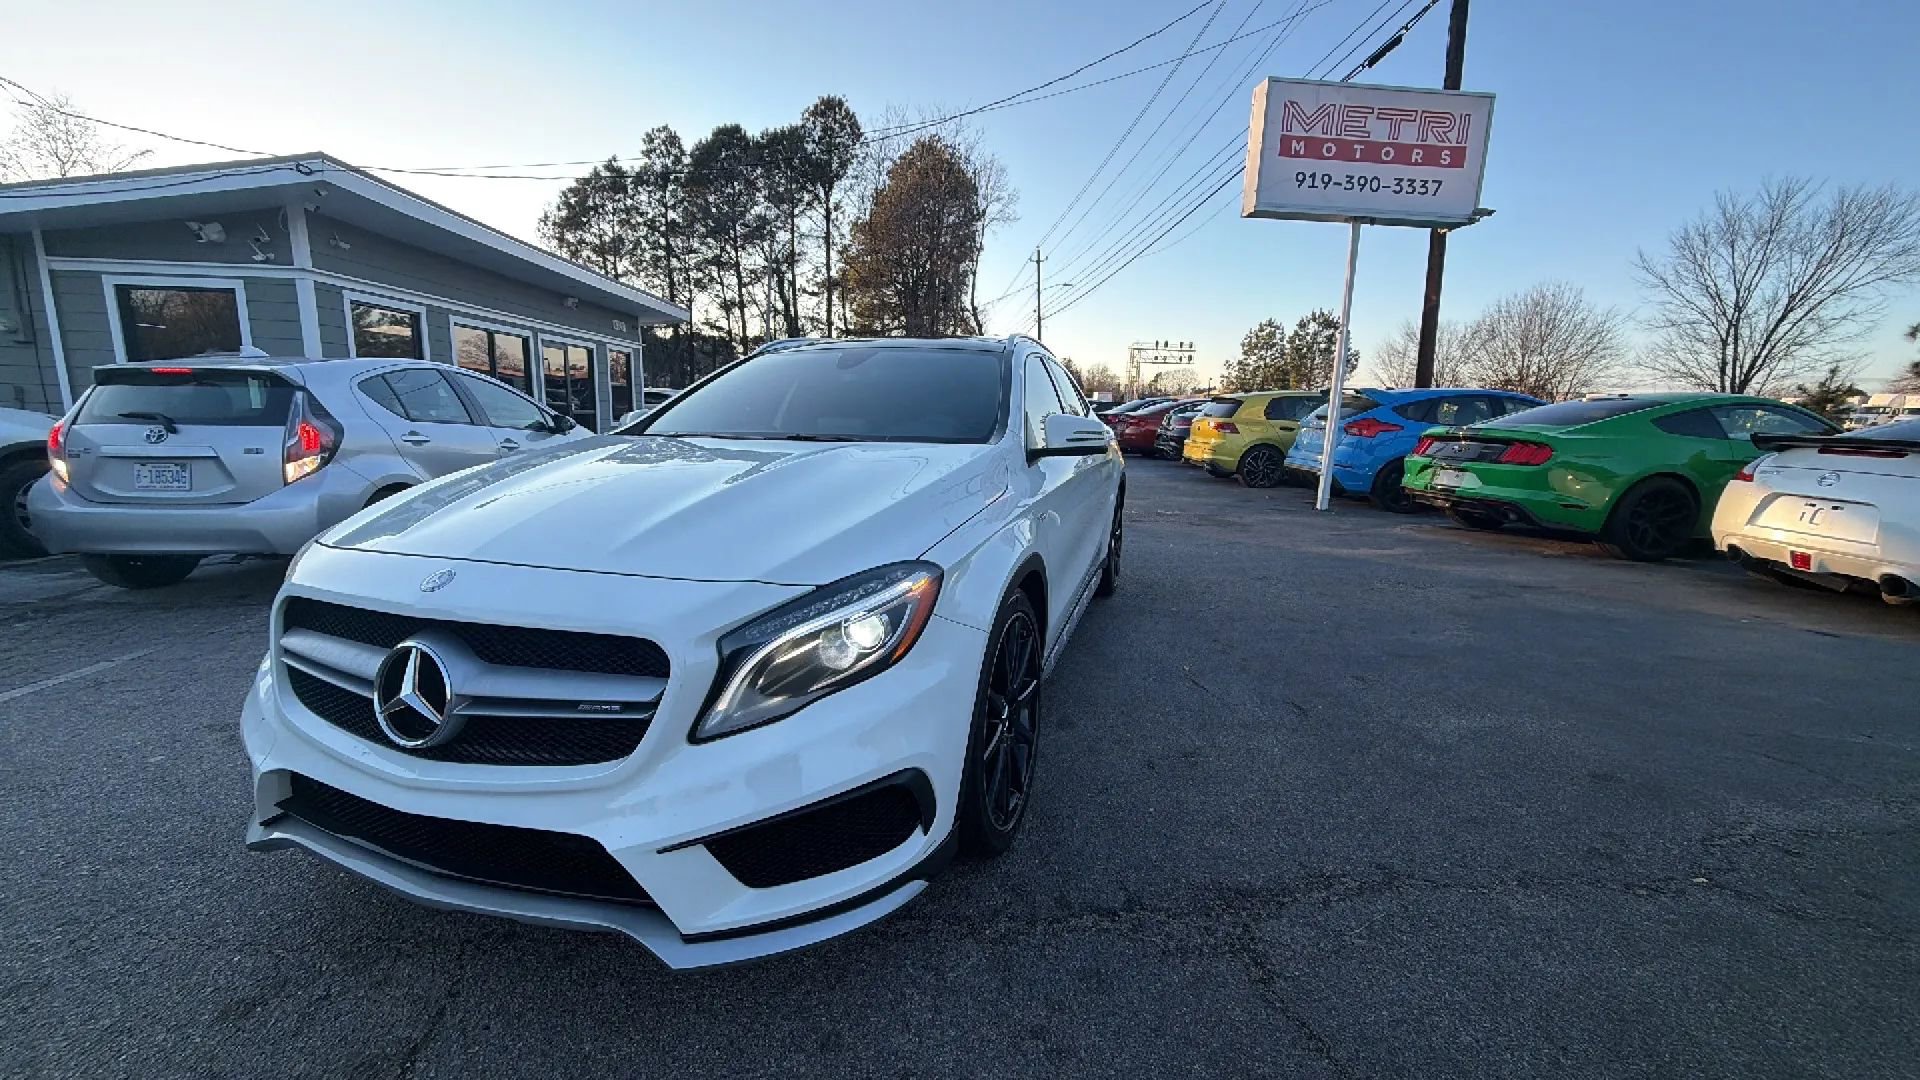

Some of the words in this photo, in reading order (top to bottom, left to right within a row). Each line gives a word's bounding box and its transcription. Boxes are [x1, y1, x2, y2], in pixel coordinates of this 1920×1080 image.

[1282, 100, 1471, 145] METRI
[1291, 139, 1451, 165] MOTORS
[1295, 171, 1443, 197] 919-390-3337
